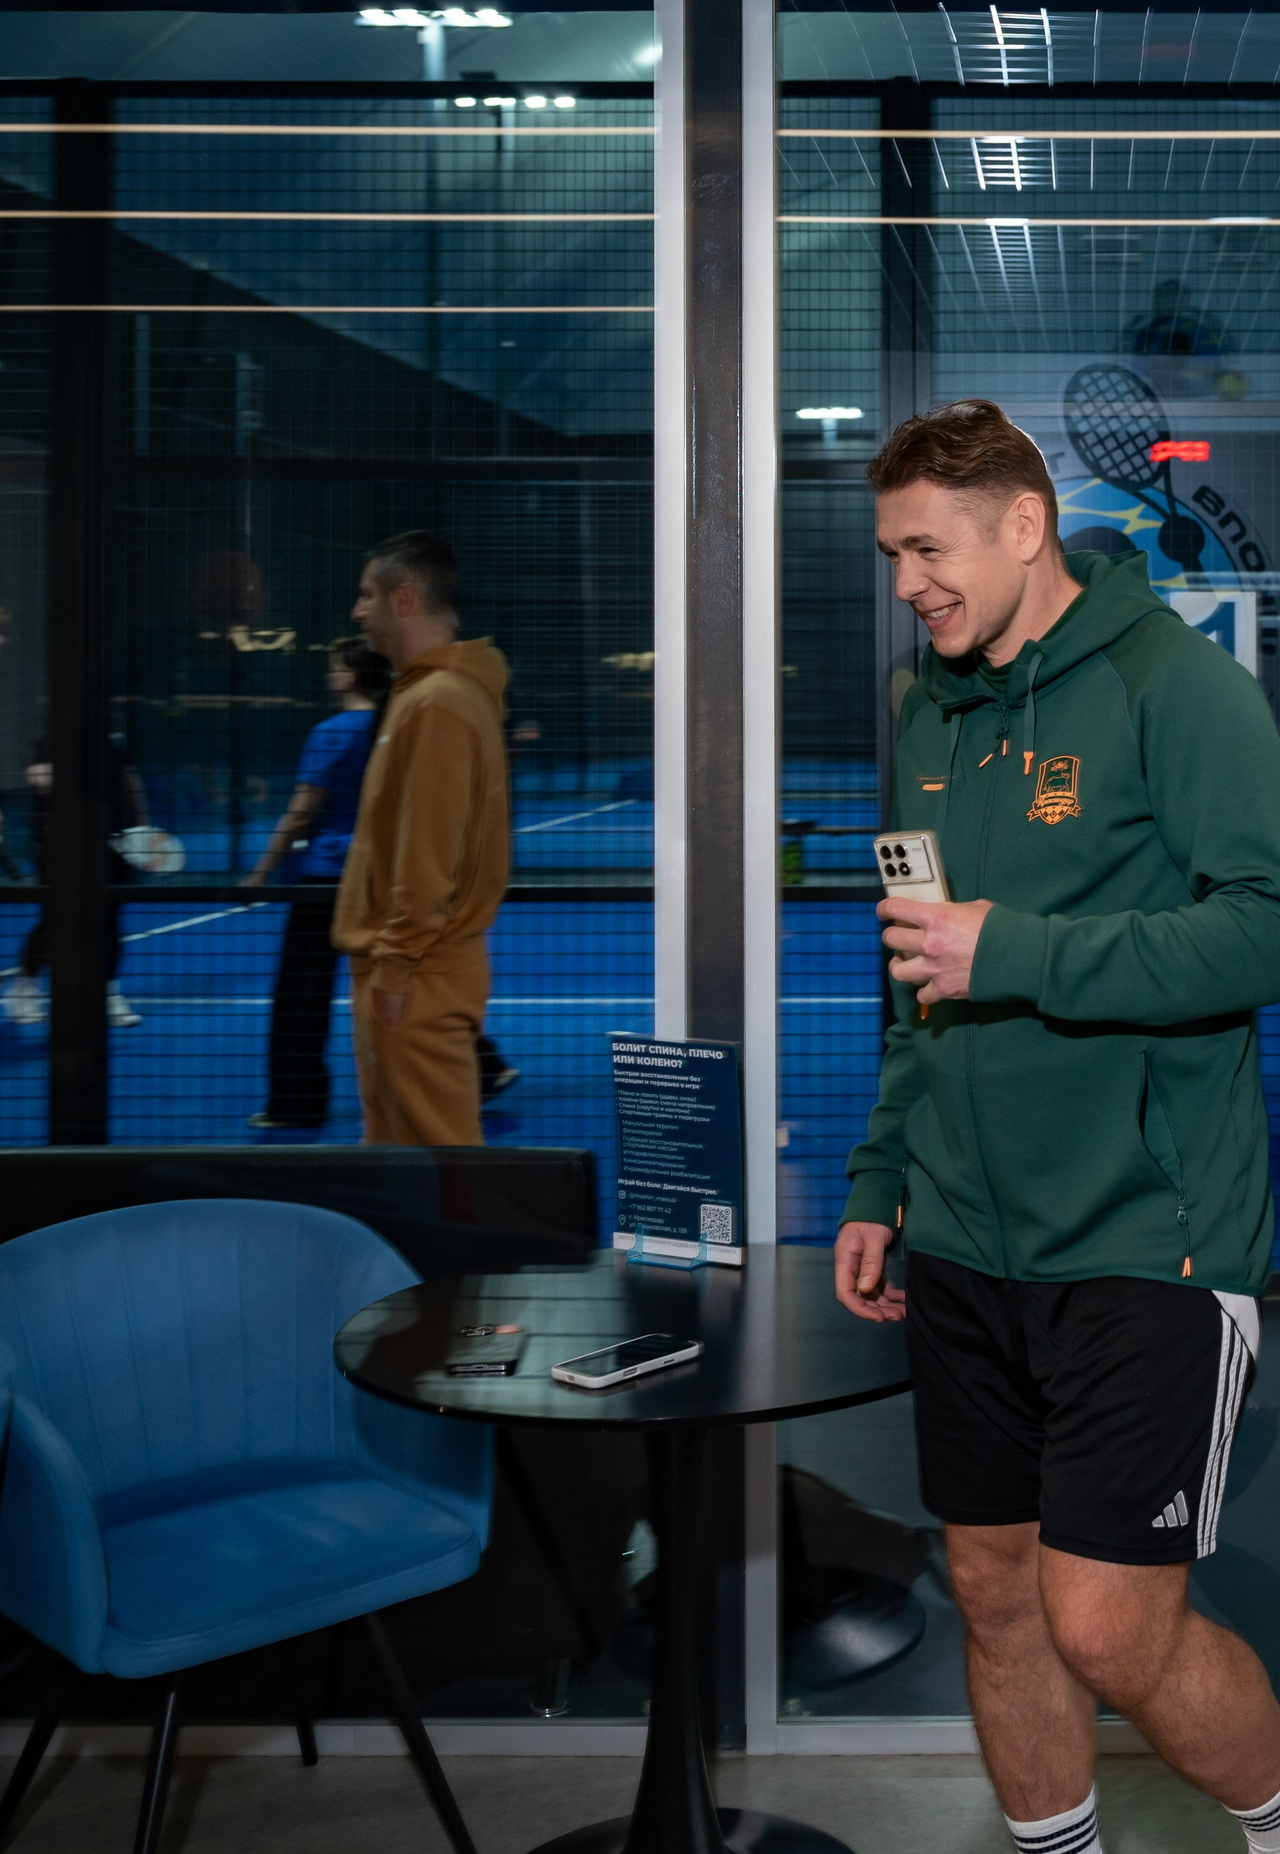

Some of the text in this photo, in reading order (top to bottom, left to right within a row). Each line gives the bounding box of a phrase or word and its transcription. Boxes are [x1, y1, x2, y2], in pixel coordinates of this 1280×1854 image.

[612, 1043, 724, 1060] БОЛИТ СПИНА, ПЛЕЧО
[613, 1055, 683, 1069] ИЛИ КОЛЕНО?
[614, 1069, 640, 1078] Быстрое
[640, 1072, 689, 1082] восстановление
[614, 1077, 644, 1085] операции
[650, 1080, 680, 1088] перерыва
[619, 1108, 652, 1116] Спортивные
[678, 1114, 710, 1122] перегрузки
[618, 1178, 635, 1186] Играй
[647, 1181, 662, 1189] боли.
[662, 1182, 691, 1193] Двигайся
[691, 1187, 718, 1196] быстрее.
